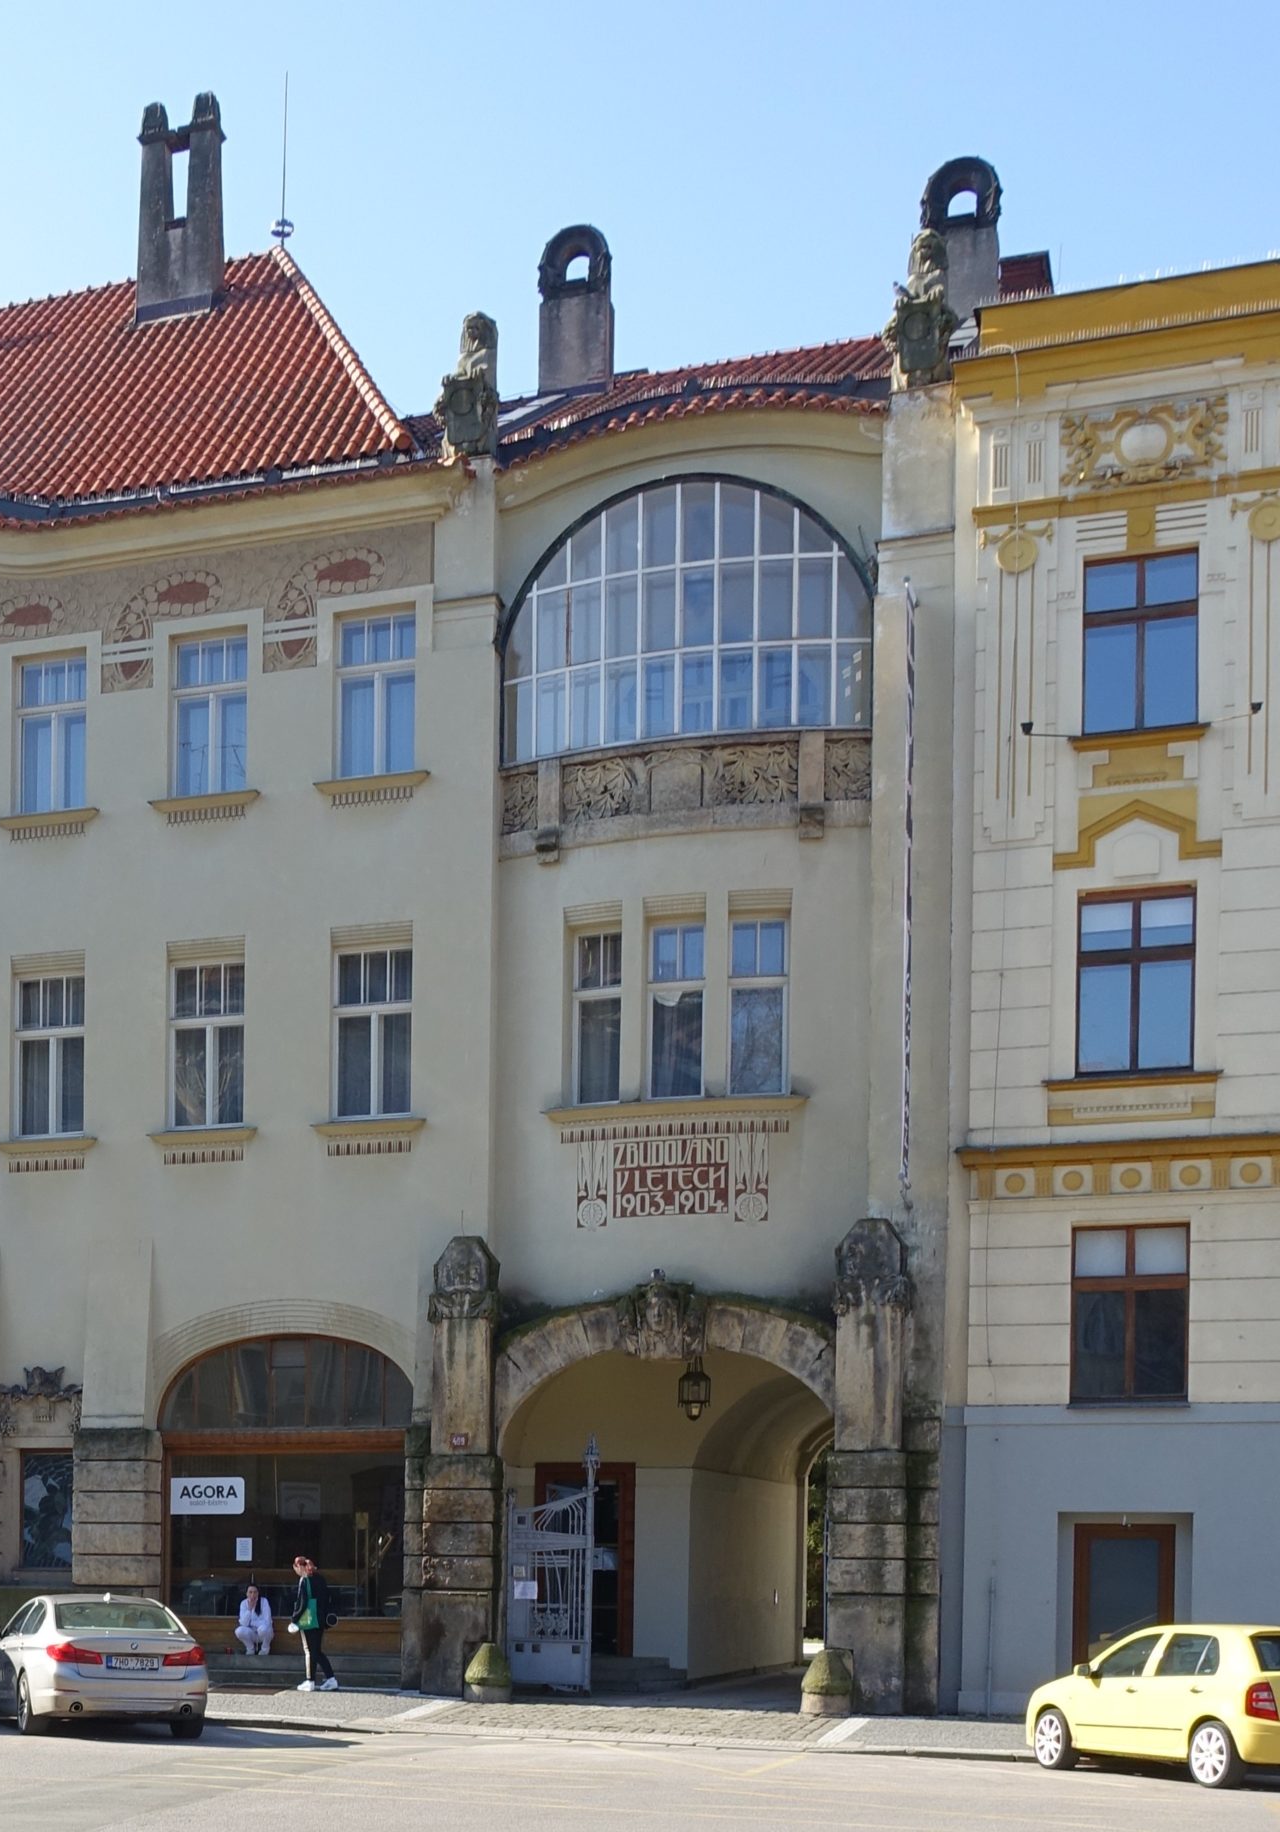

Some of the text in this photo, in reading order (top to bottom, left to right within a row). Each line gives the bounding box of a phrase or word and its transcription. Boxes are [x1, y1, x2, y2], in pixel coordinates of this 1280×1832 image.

[614, 1136, 729, 1168] ZBUDOVÁNO
[616, 1166, 726, 1194] V LETECH
[180, 1485, 238, 1499] AGORA
